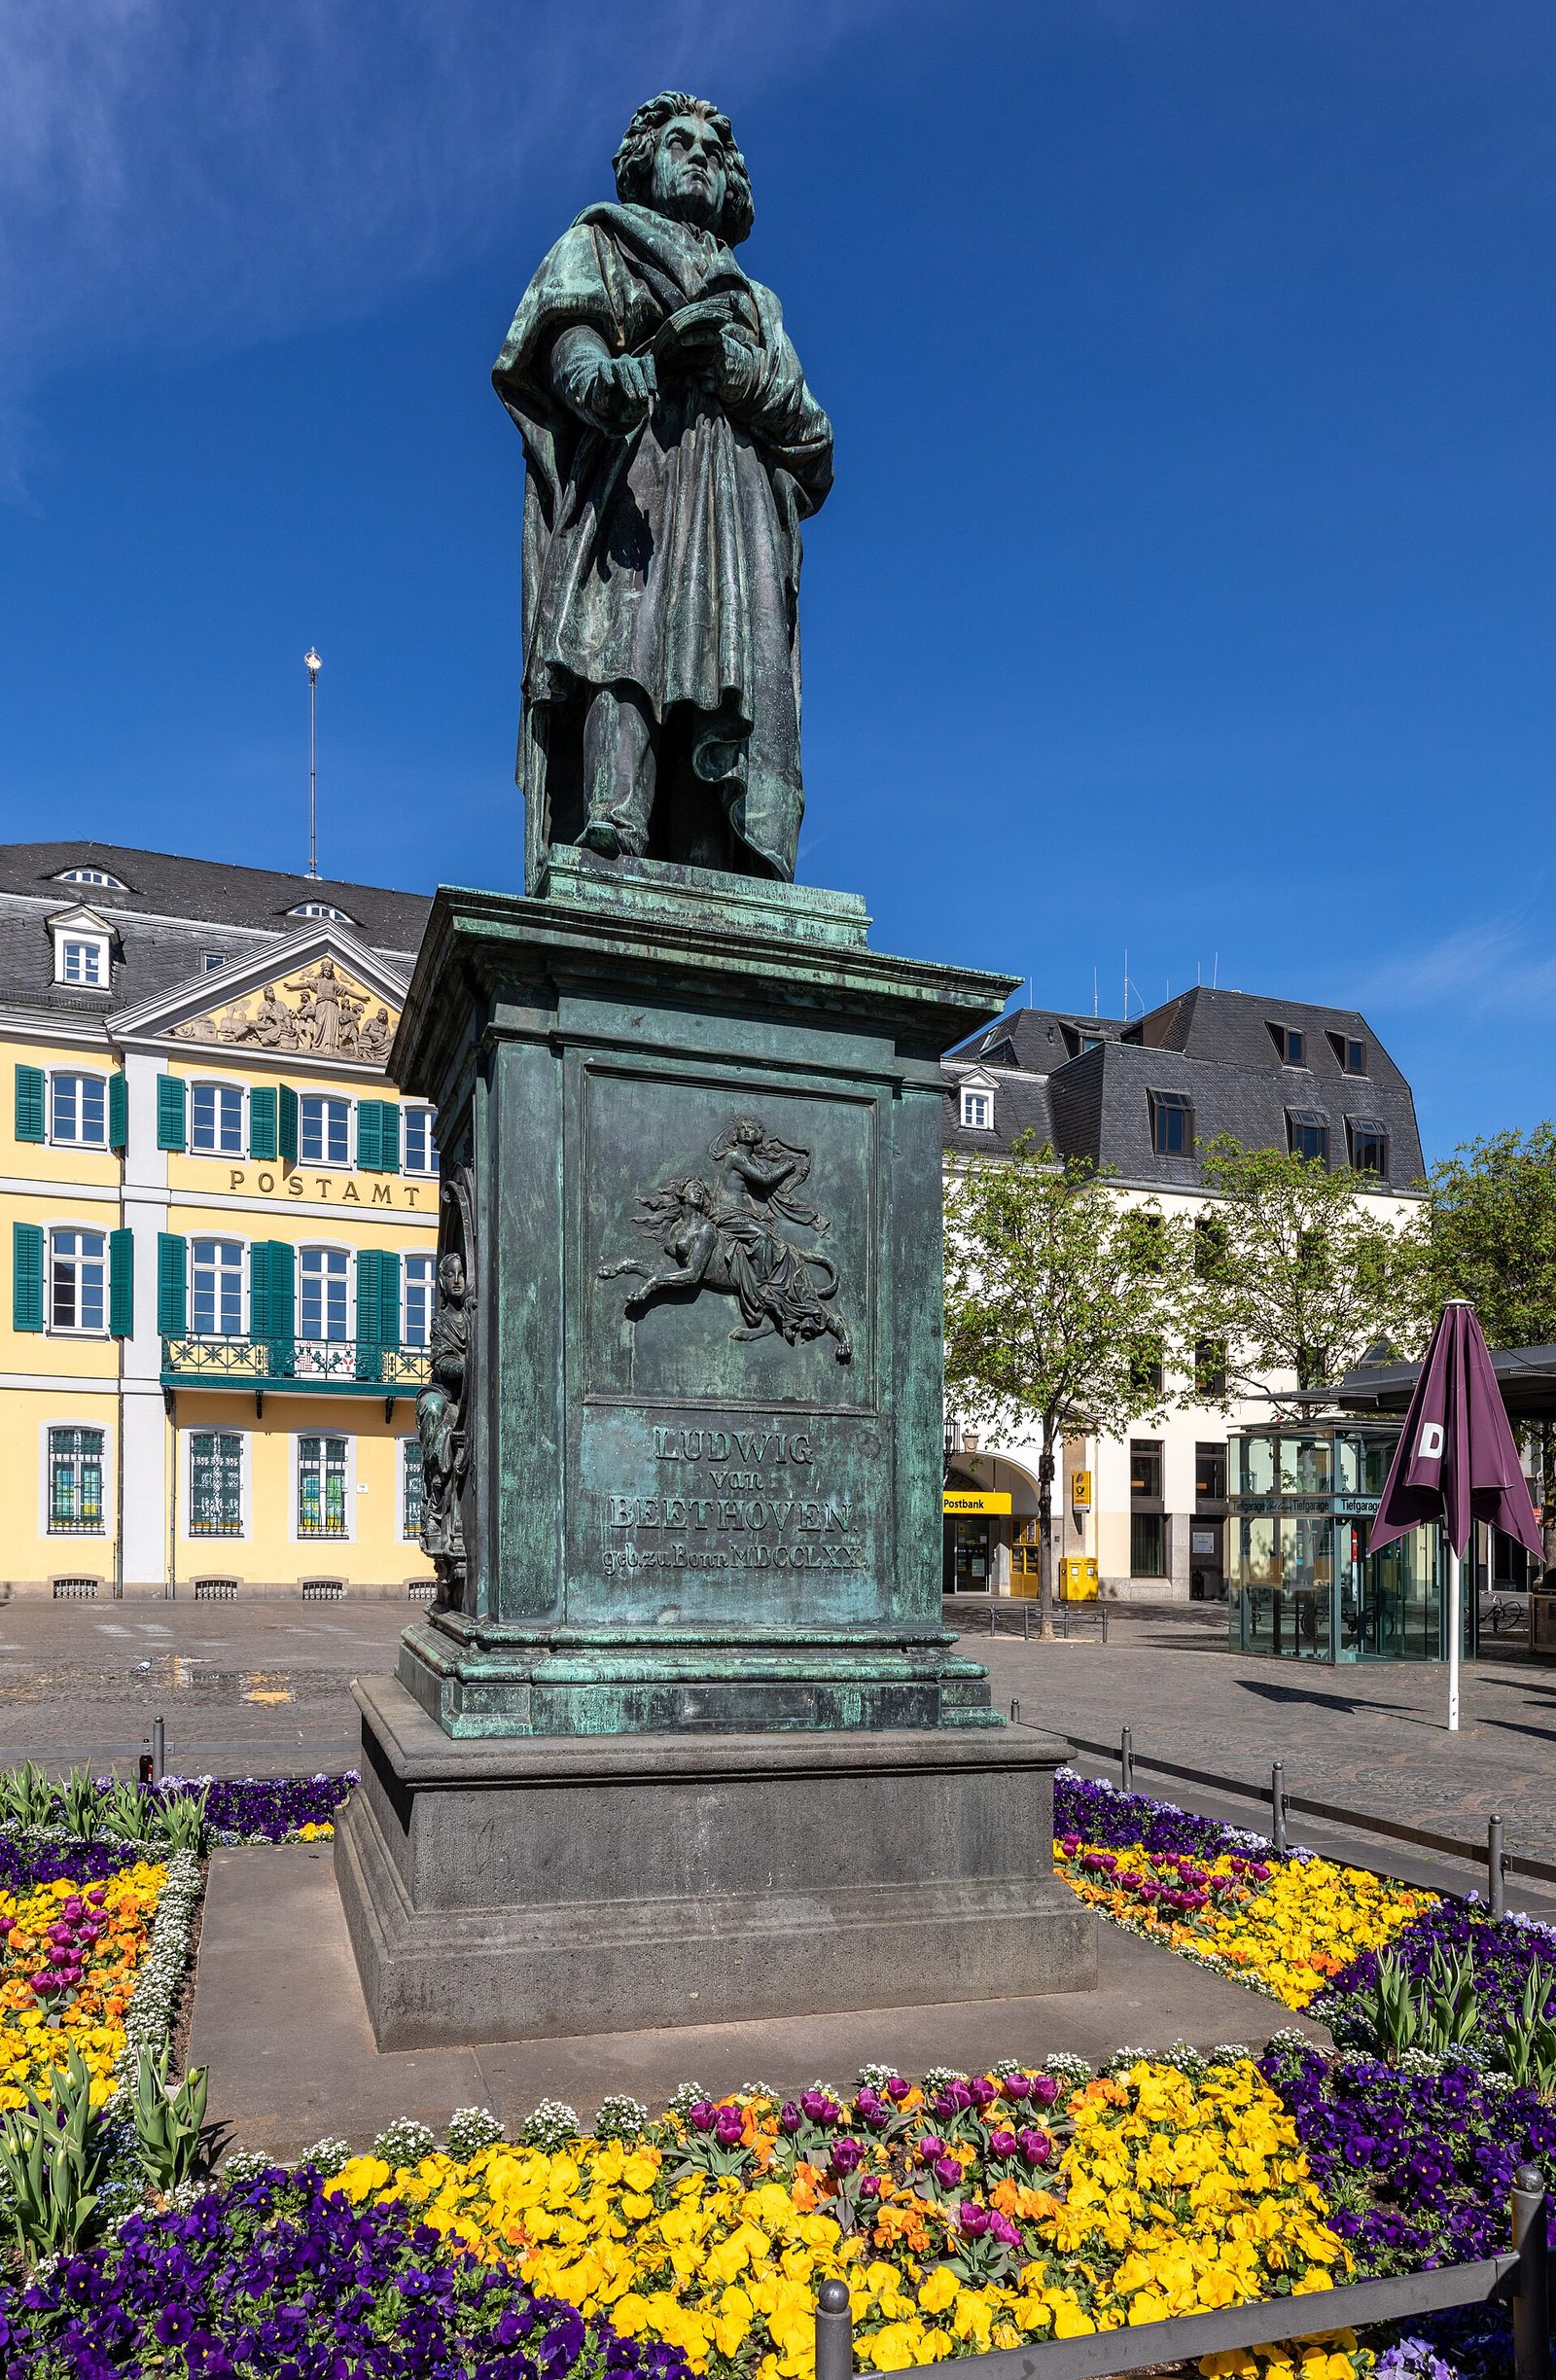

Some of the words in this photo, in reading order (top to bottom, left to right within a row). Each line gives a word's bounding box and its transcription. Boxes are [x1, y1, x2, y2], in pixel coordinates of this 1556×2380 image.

[230, 1169, 420, 1206] POSTAMT
[653, 1426, 813, 1465] LUDWIG
[709, 1470, 763, 1491] van
[609, 1495, 859, 1533] BEETHOVEN.
[943, 1499, 984, 1509] Postbank
[1232, 1500, 1265, 1513] Tiefgarage
[1291, 1500, 1329, 1513] Tiefgarage
[602, 1543, 642, 1576] geb.
[643, 1553, 671, 1568] zu
[672, 1544, 729, 1569] Bonn
